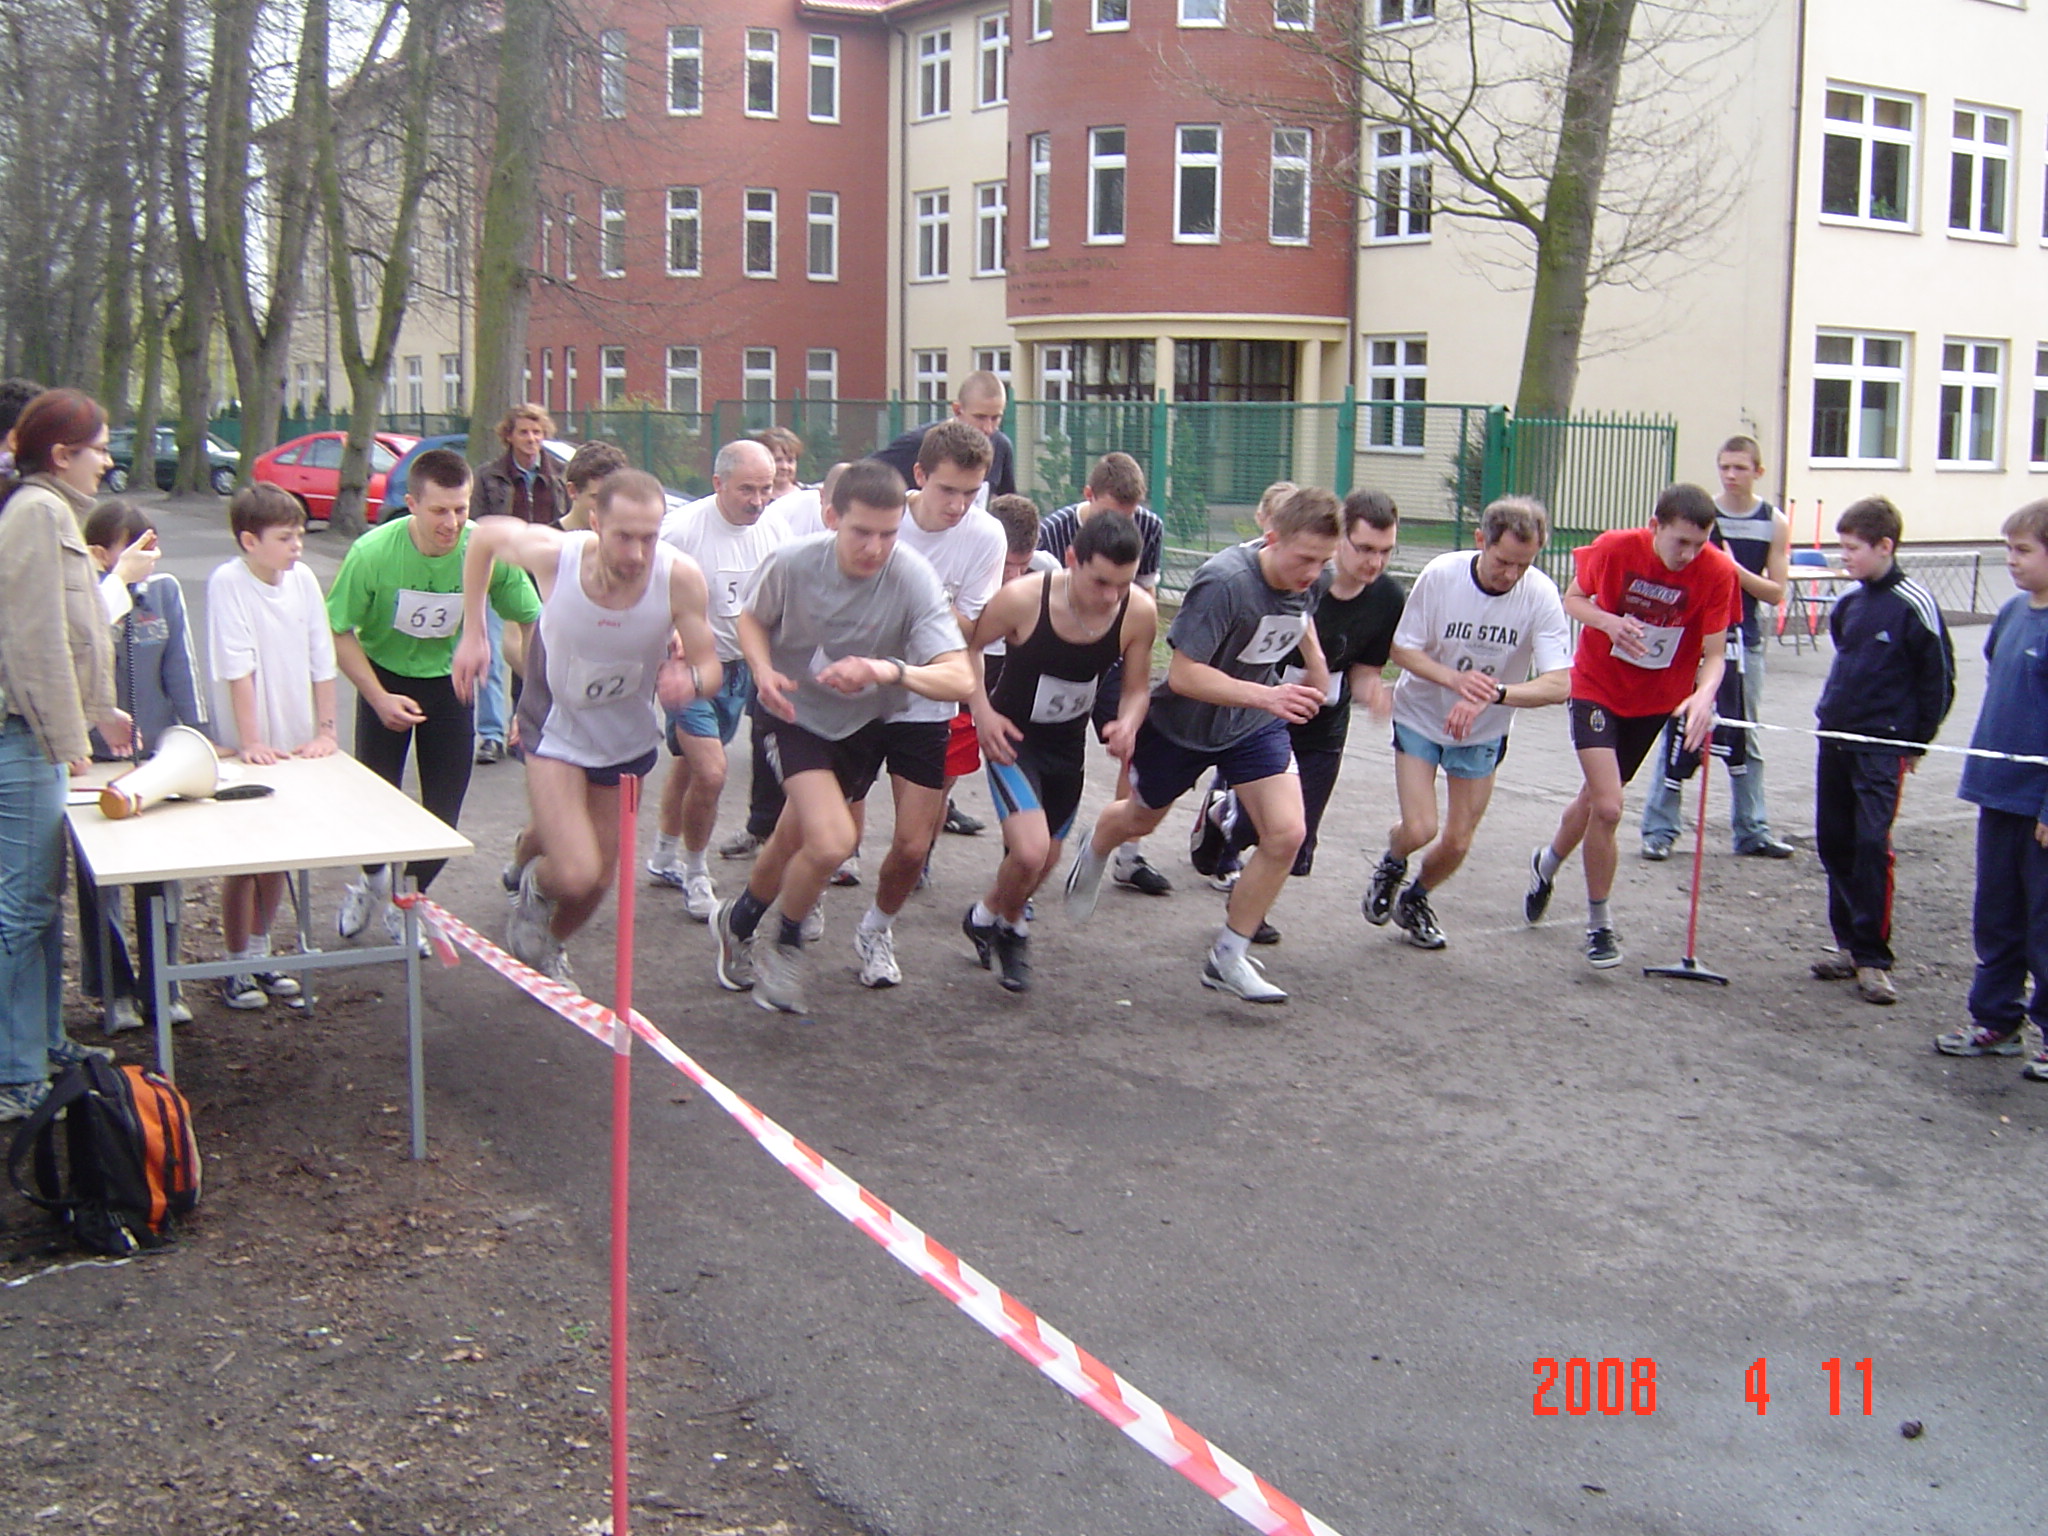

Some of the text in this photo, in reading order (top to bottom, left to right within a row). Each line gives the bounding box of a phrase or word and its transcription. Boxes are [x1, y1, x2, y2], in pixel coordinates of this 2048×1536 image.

[410, 605, 448, 628] 63
[1258, 630, 1296, 654] 59
[1444, 622, 1519, 647] BIG STAR
[586, 675, 625, 700] 62
